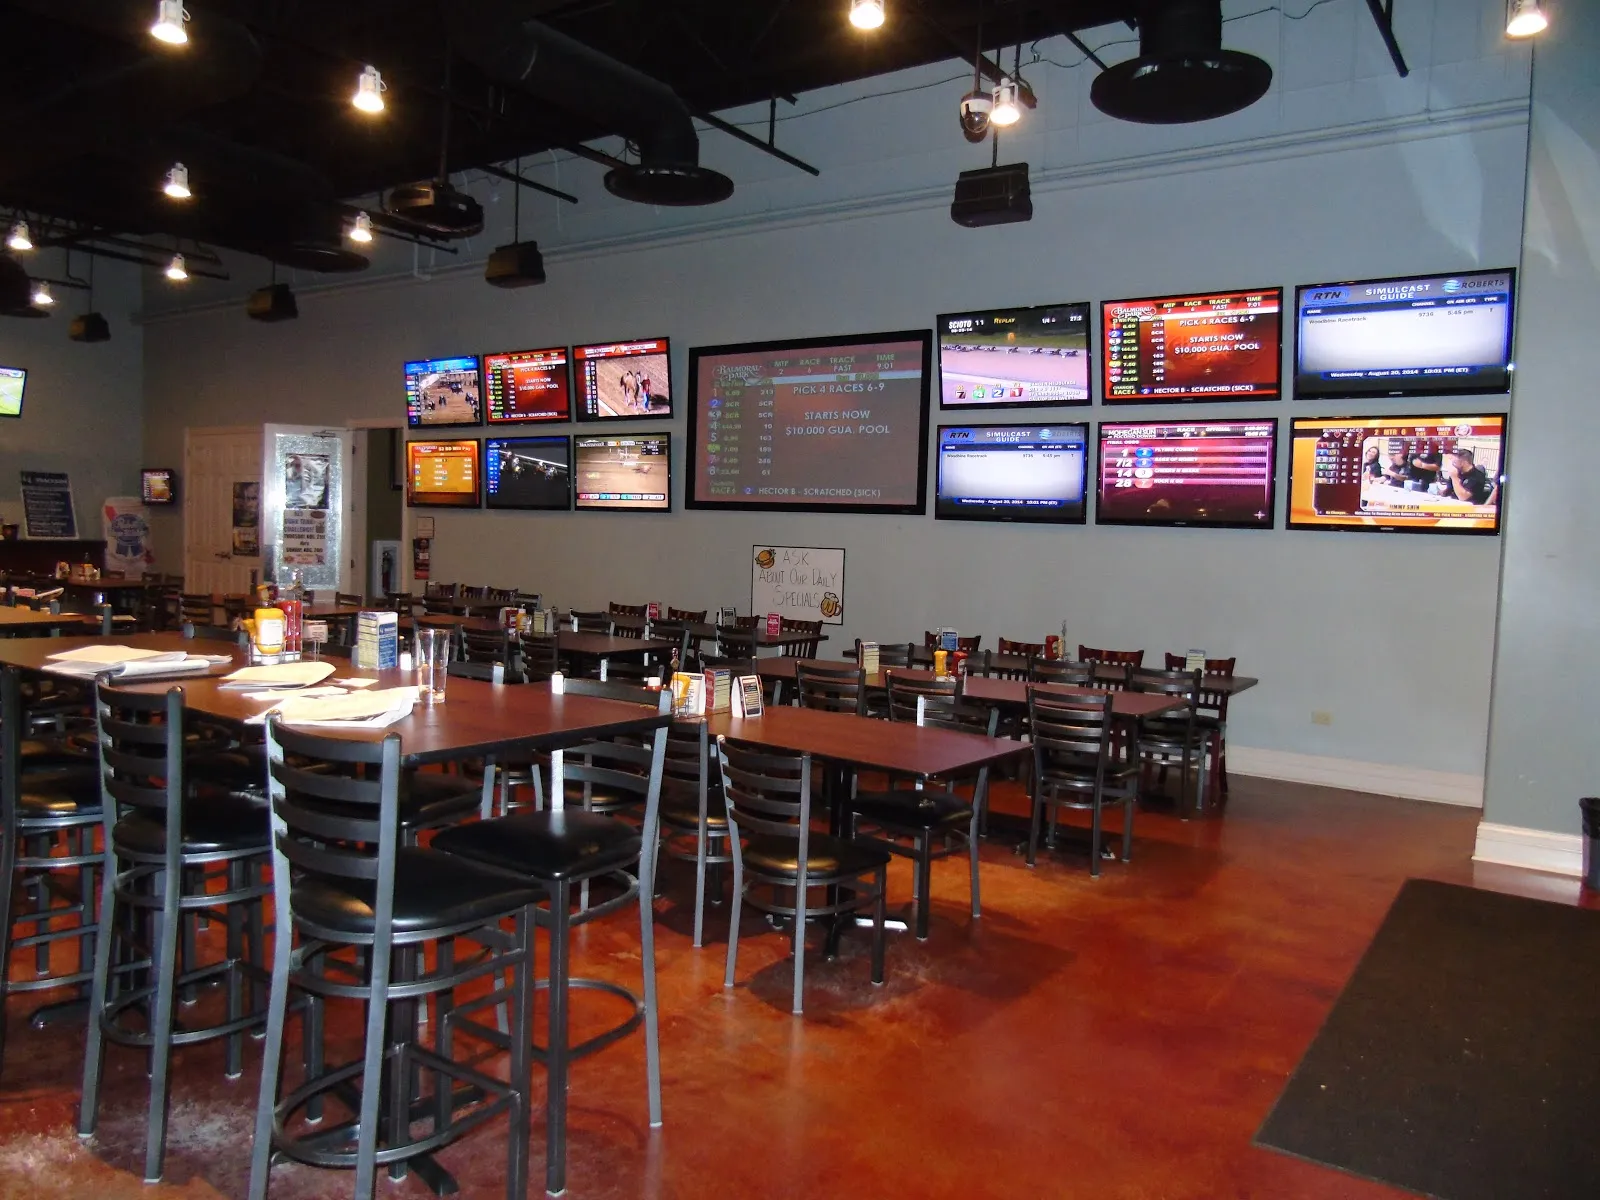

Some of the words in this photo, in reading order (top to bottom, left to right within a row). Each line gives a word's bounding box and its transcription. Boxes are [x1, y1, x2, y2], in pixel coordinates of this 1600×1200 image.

[1461, 279, 1505, 289] ROBERTS
[1313, 291, 1342, 300] RTN
[1365, 284, 1430, 296] SIMULCAST
[1380, 292, 1414, 300] GUIDE
[948, 320, 972, 329] SCIOTO
[1190, 335, 1218, 343] STARTS
[1174, 346, 1208, 354] $10,000
[830, 356, 856, 364] TRACK
[833, 364, 852, 372] FAST
[793, 386, 816, 395] PICK
[820, 384, 826, 393] 4
[829, 384, 864, 393] RACES
[867, 382, 885, 392] 6-9
[1232, 384, 1254, 392] (SICK)
[804, 411, 838, 420] STARTS
[842, 410, 870, 420] NOW
[786, 426, 825, 436] $10,000
[828, 426, 855, 435] GUA.
[858, 424, 890, 434] POOL
[711, 432, 718, 442] 5
[1122, 448, 1129, 457] 1
[1116, 469, 1132, 478] 14
[758, 487, 789, 495] HECTOR
[804, 488, 852, 496] SCRATCHED
[854, 488, 881, 498] (SICK)
[782, 550, 809, 566] ASK
[758, 569, 785, 584] ABOUT
[812, 568, 837, 588] DAILY
[772, 584, 820, 609] SPECIALS
